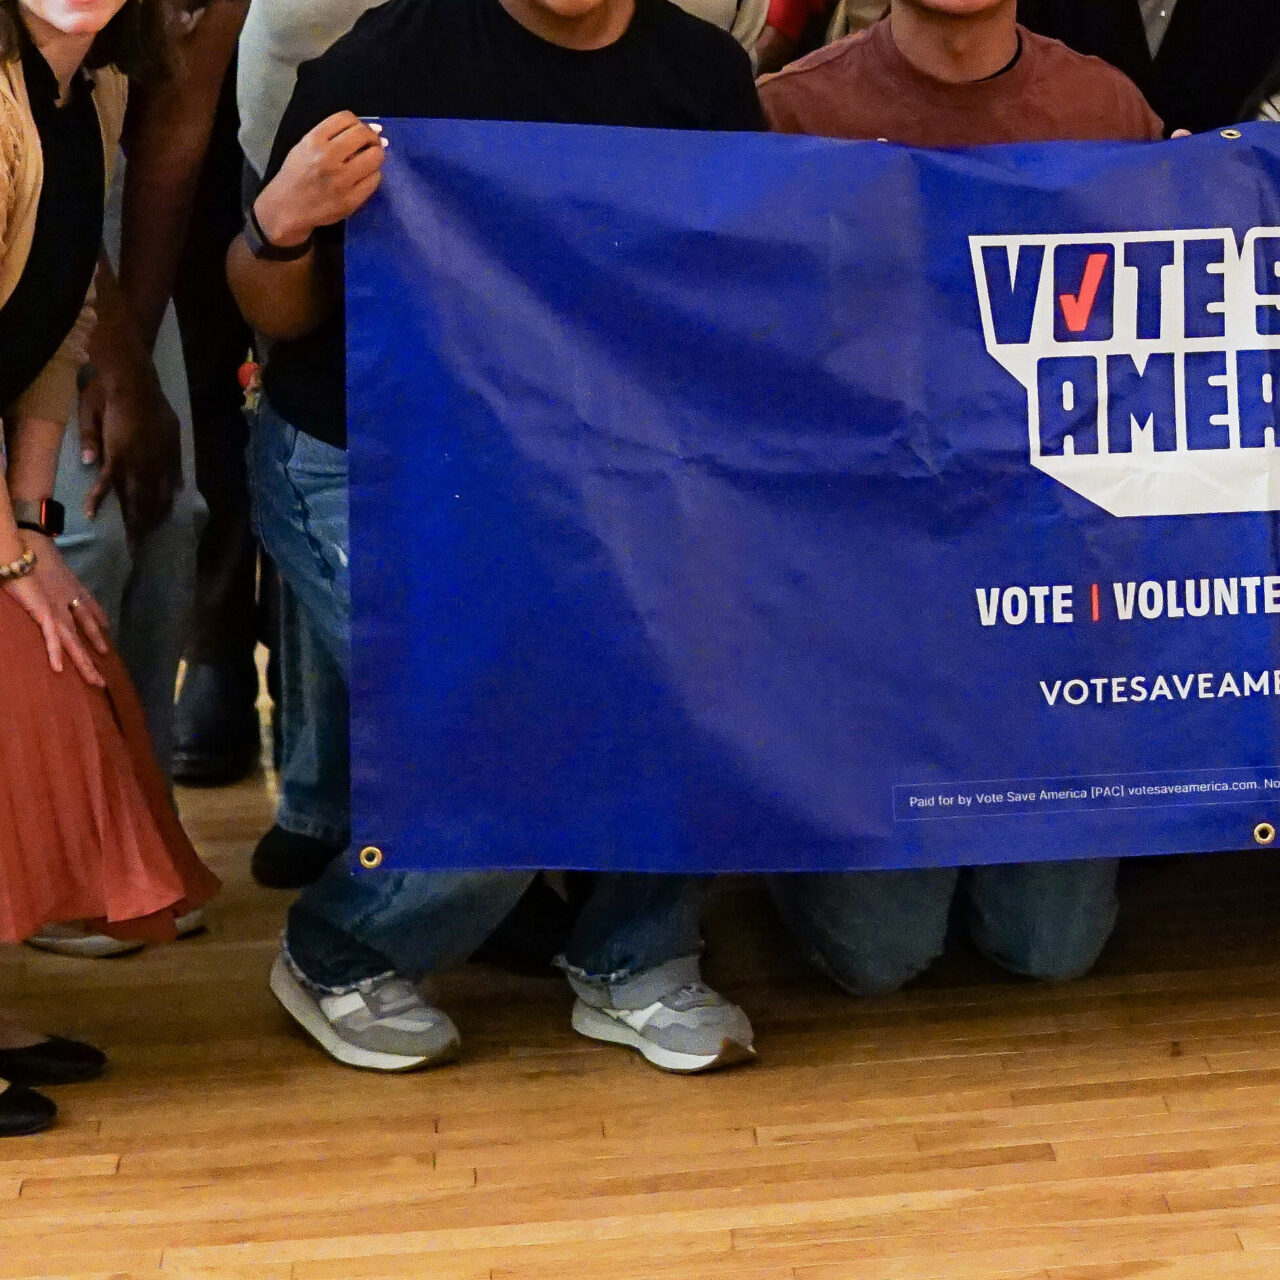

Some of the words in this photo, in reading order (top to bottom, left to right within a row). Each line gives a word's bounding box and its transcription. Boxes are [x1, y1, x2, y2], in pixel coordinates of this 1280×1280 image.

[980, 238, 1226, 345] VOTE
[975, 584, 1074, 626] VOTE
[909, 796, 935, 807] Paid
[938, 795, 954, 806] for
[958, 794, 972, 806] by
[976, 792, 1004, 804] Vote
[1006, 791, 1036, 802] Save
[1039, 789, 1088, 801] America
[1091, 785, 1125, 799] [PAC]
[1128, 781, 1261, 796] votesaveamerica.com.
